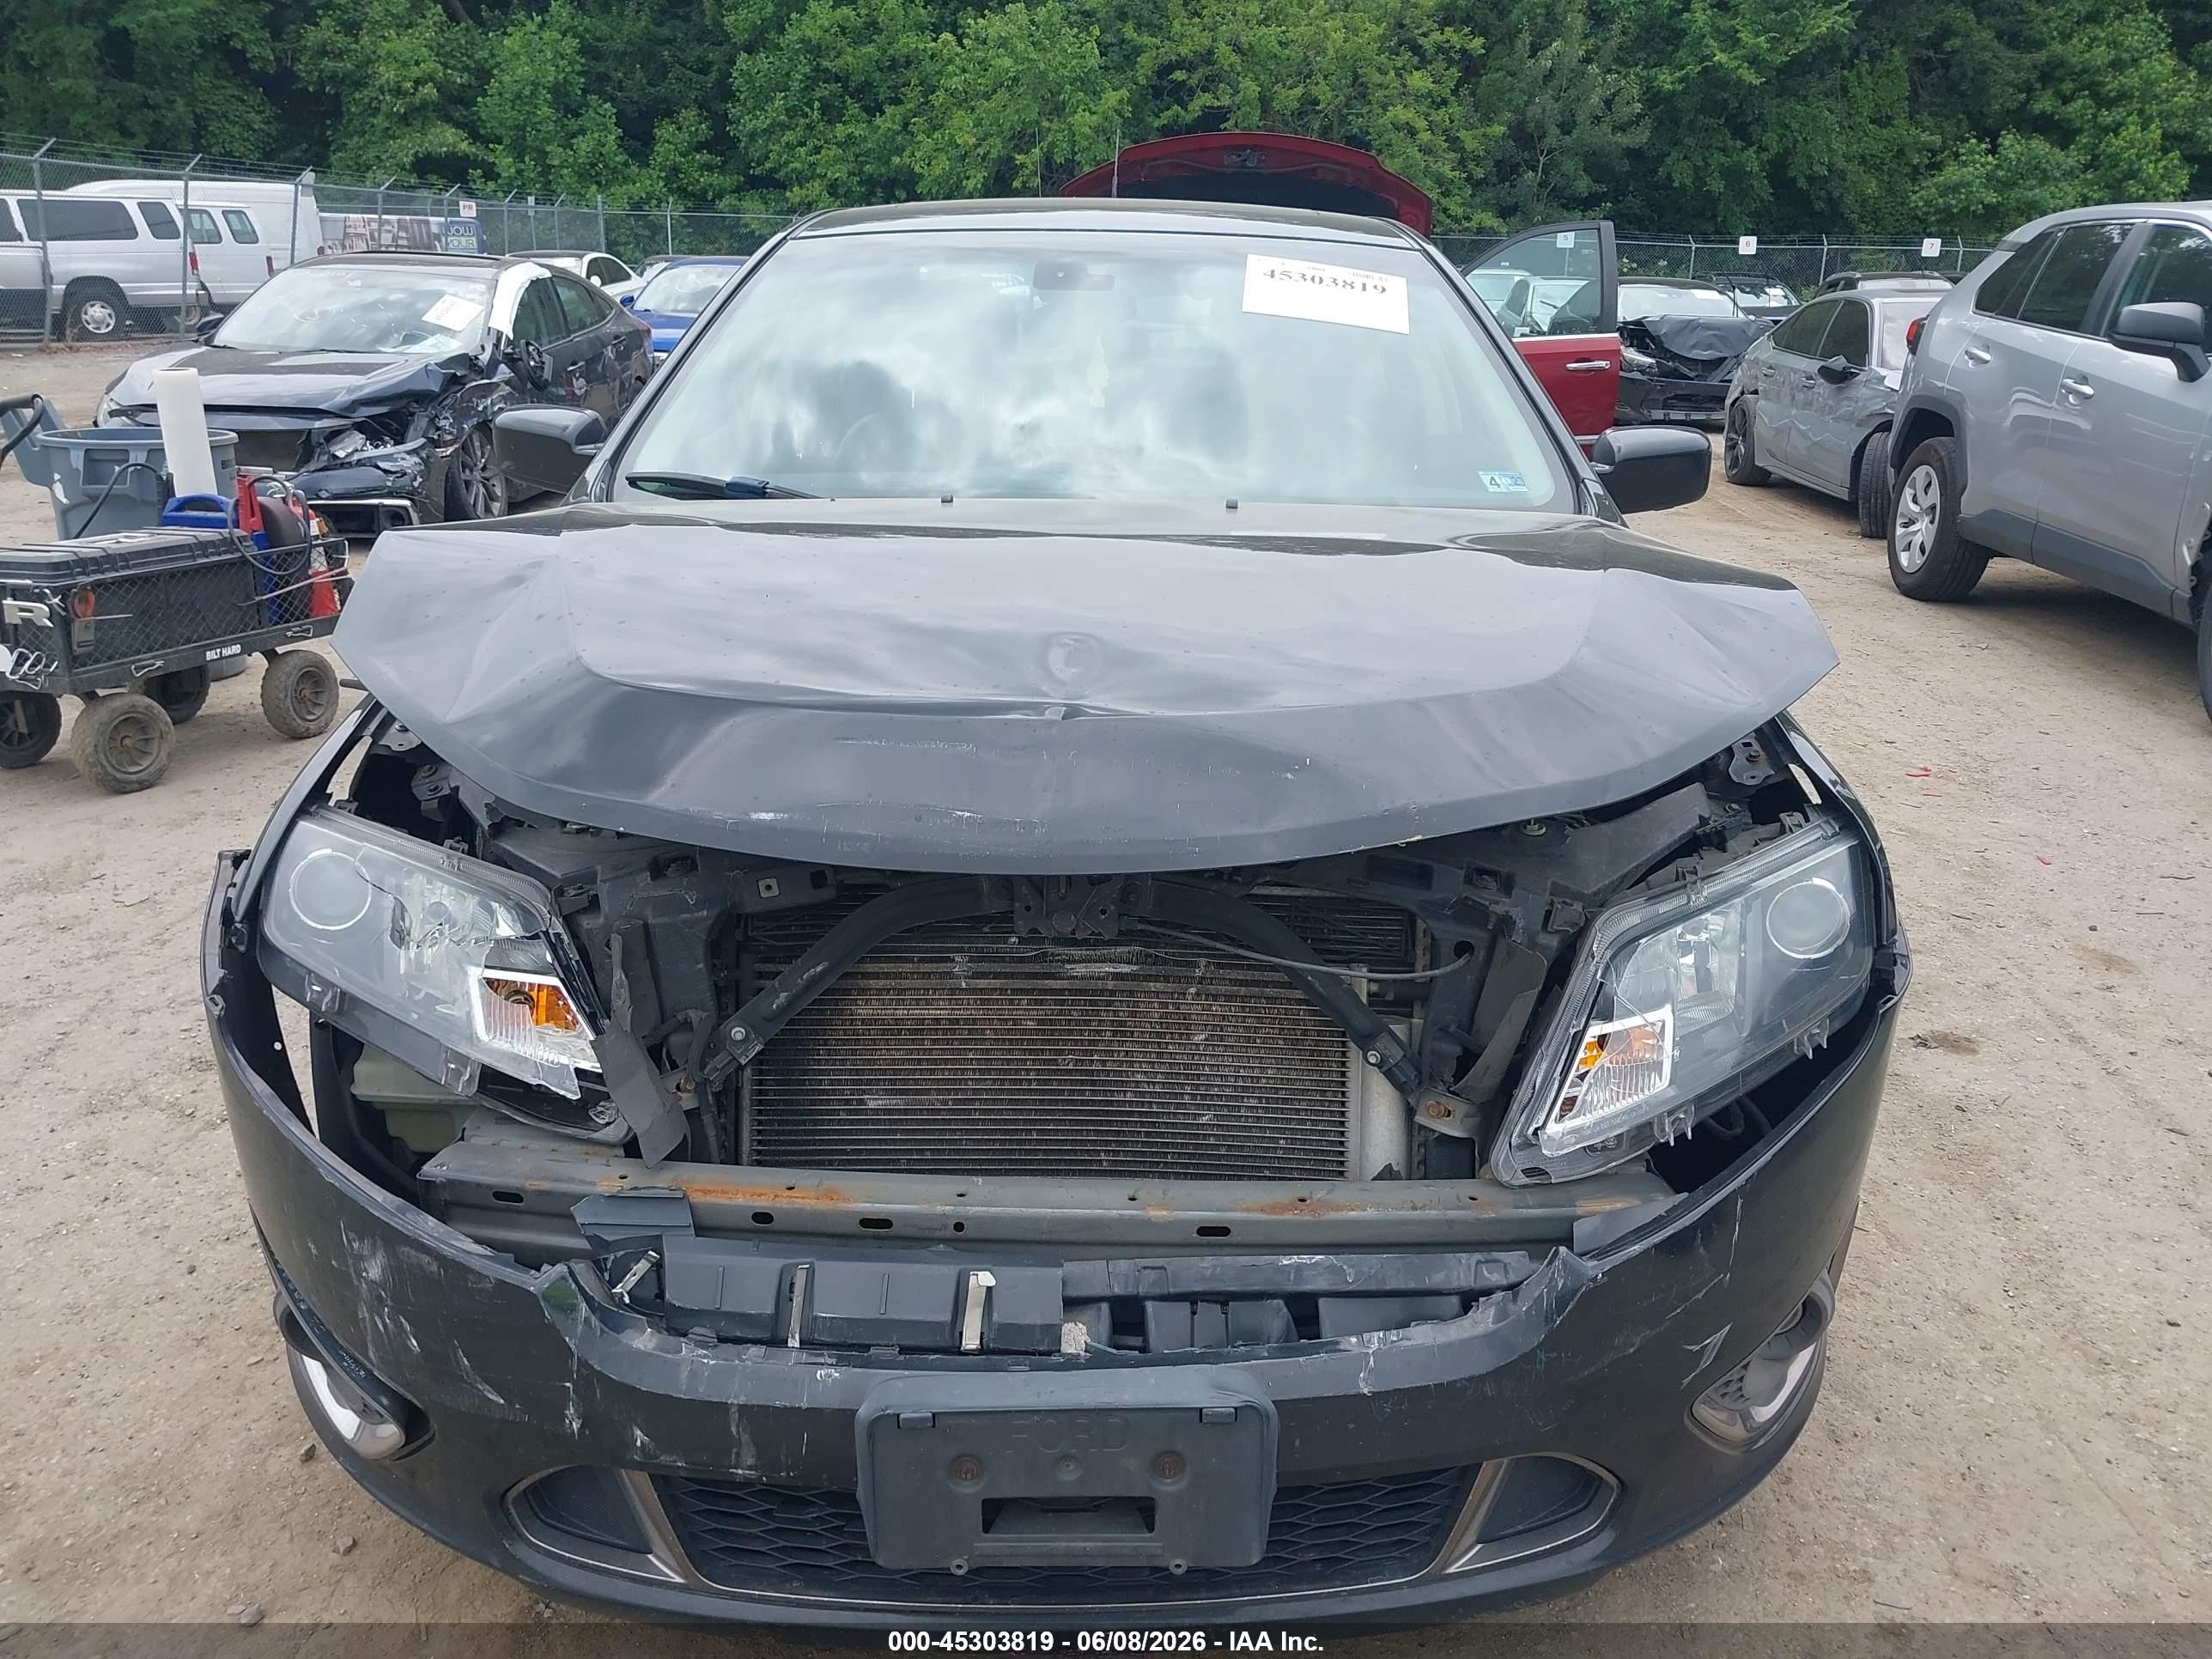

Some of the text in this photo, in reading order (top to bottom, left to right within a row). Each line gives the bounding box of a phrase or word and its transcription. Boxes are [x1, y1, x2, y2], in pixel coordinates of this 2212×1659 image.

[1263, 269, 1387, 294] 45303819
[1490, 476, 1499, 486] 4
[206, 644, 241, 660] BILT HARD
[1006, 1419, 1129, 1453] FORD
